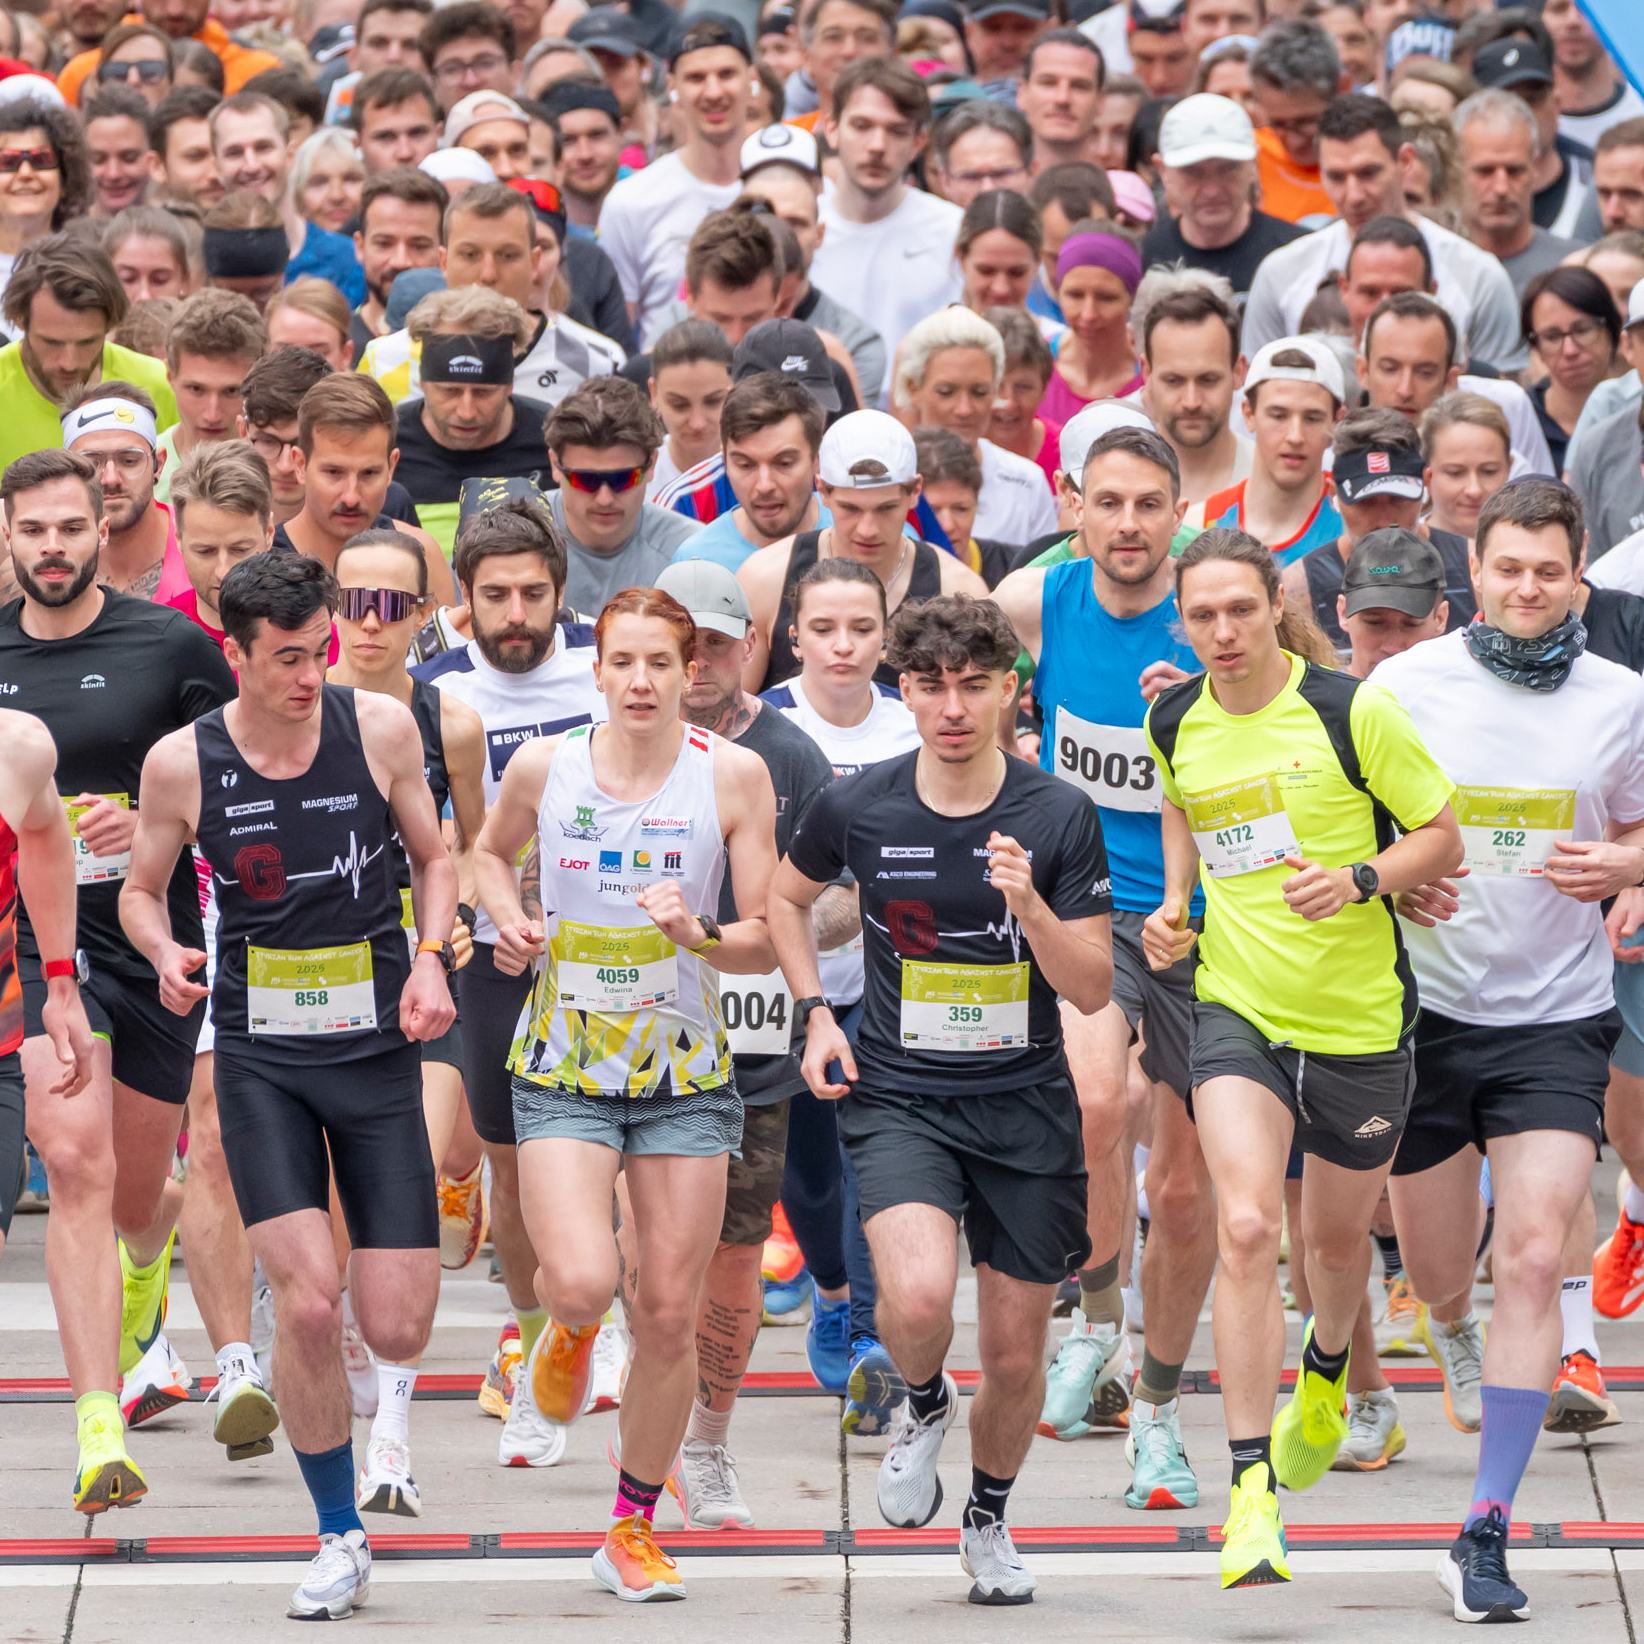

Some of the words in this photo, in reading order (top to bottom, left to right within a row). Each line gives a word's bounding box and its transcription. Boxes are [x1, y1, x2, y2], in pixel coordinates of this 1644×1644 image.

[449, 364, 483, 374] skinfit
[80, 681, 106, 689] skinfit
[503, 729, 534, 744] BKW
[1060, 736, 1156, 791] 9003
[301, 793, 358, 809] MAGNESIUM
[327, 802, 358, 812] SPORT
[1209, 798, 1236, 814] 2025
[1497, 802, 1527, 813] 2025
[231, 806, 249, 815] giga
[250, 802, 272, 811] sport
[229, 821, 278, 836] ADMIRAL
[650, 818, 688, 827] Wallner
[1216, 824, 1254, 848] 4172
[1492, 830, 1526, 847] 262
[888, 848, 907, 857] giga
[908, 848, 932, 857] sport
[1226, 844, 1252, 856] Michael
[1496, 849, 1521, 858] Stefan
[559, 857, 590, 871] EJOT
[664, 854, 682, 869] fit
[234, 844, 286, 900] G
[565, 925, 593, 936] STYRIAN
[608, 930, 640, 939] AGAINST
[884, 900, 938, 954] G
[255, 951, 286, 961] STYRIAN
[288, 952, 303, 961] RUN
[304, 952, 336, 961] AGAINST
[338, 946, 365, 958] CANCER
[601, 941, 630, 952] 2025
[296, 963, 326, 975] 2025
[596, 967, 640, 985] 4059
[911, 965, 942, 975] STYRIAN
[943, 967, 959, 975] RUN
[960, 967, 994, 976] AGAINST
[995, 967, 1022, 976] CANCER
[604, 986, 633, 994] Edwina
[952, 979, 981, 989] 2025
[294, 990, 329, 1007] 858
[720, 990, 787, 1031] 004
[948, 1005, 983, 1022] 359
[942, 1024, 989, 1033] Christopher
[1562, 1280, 1588, 1291] ep
